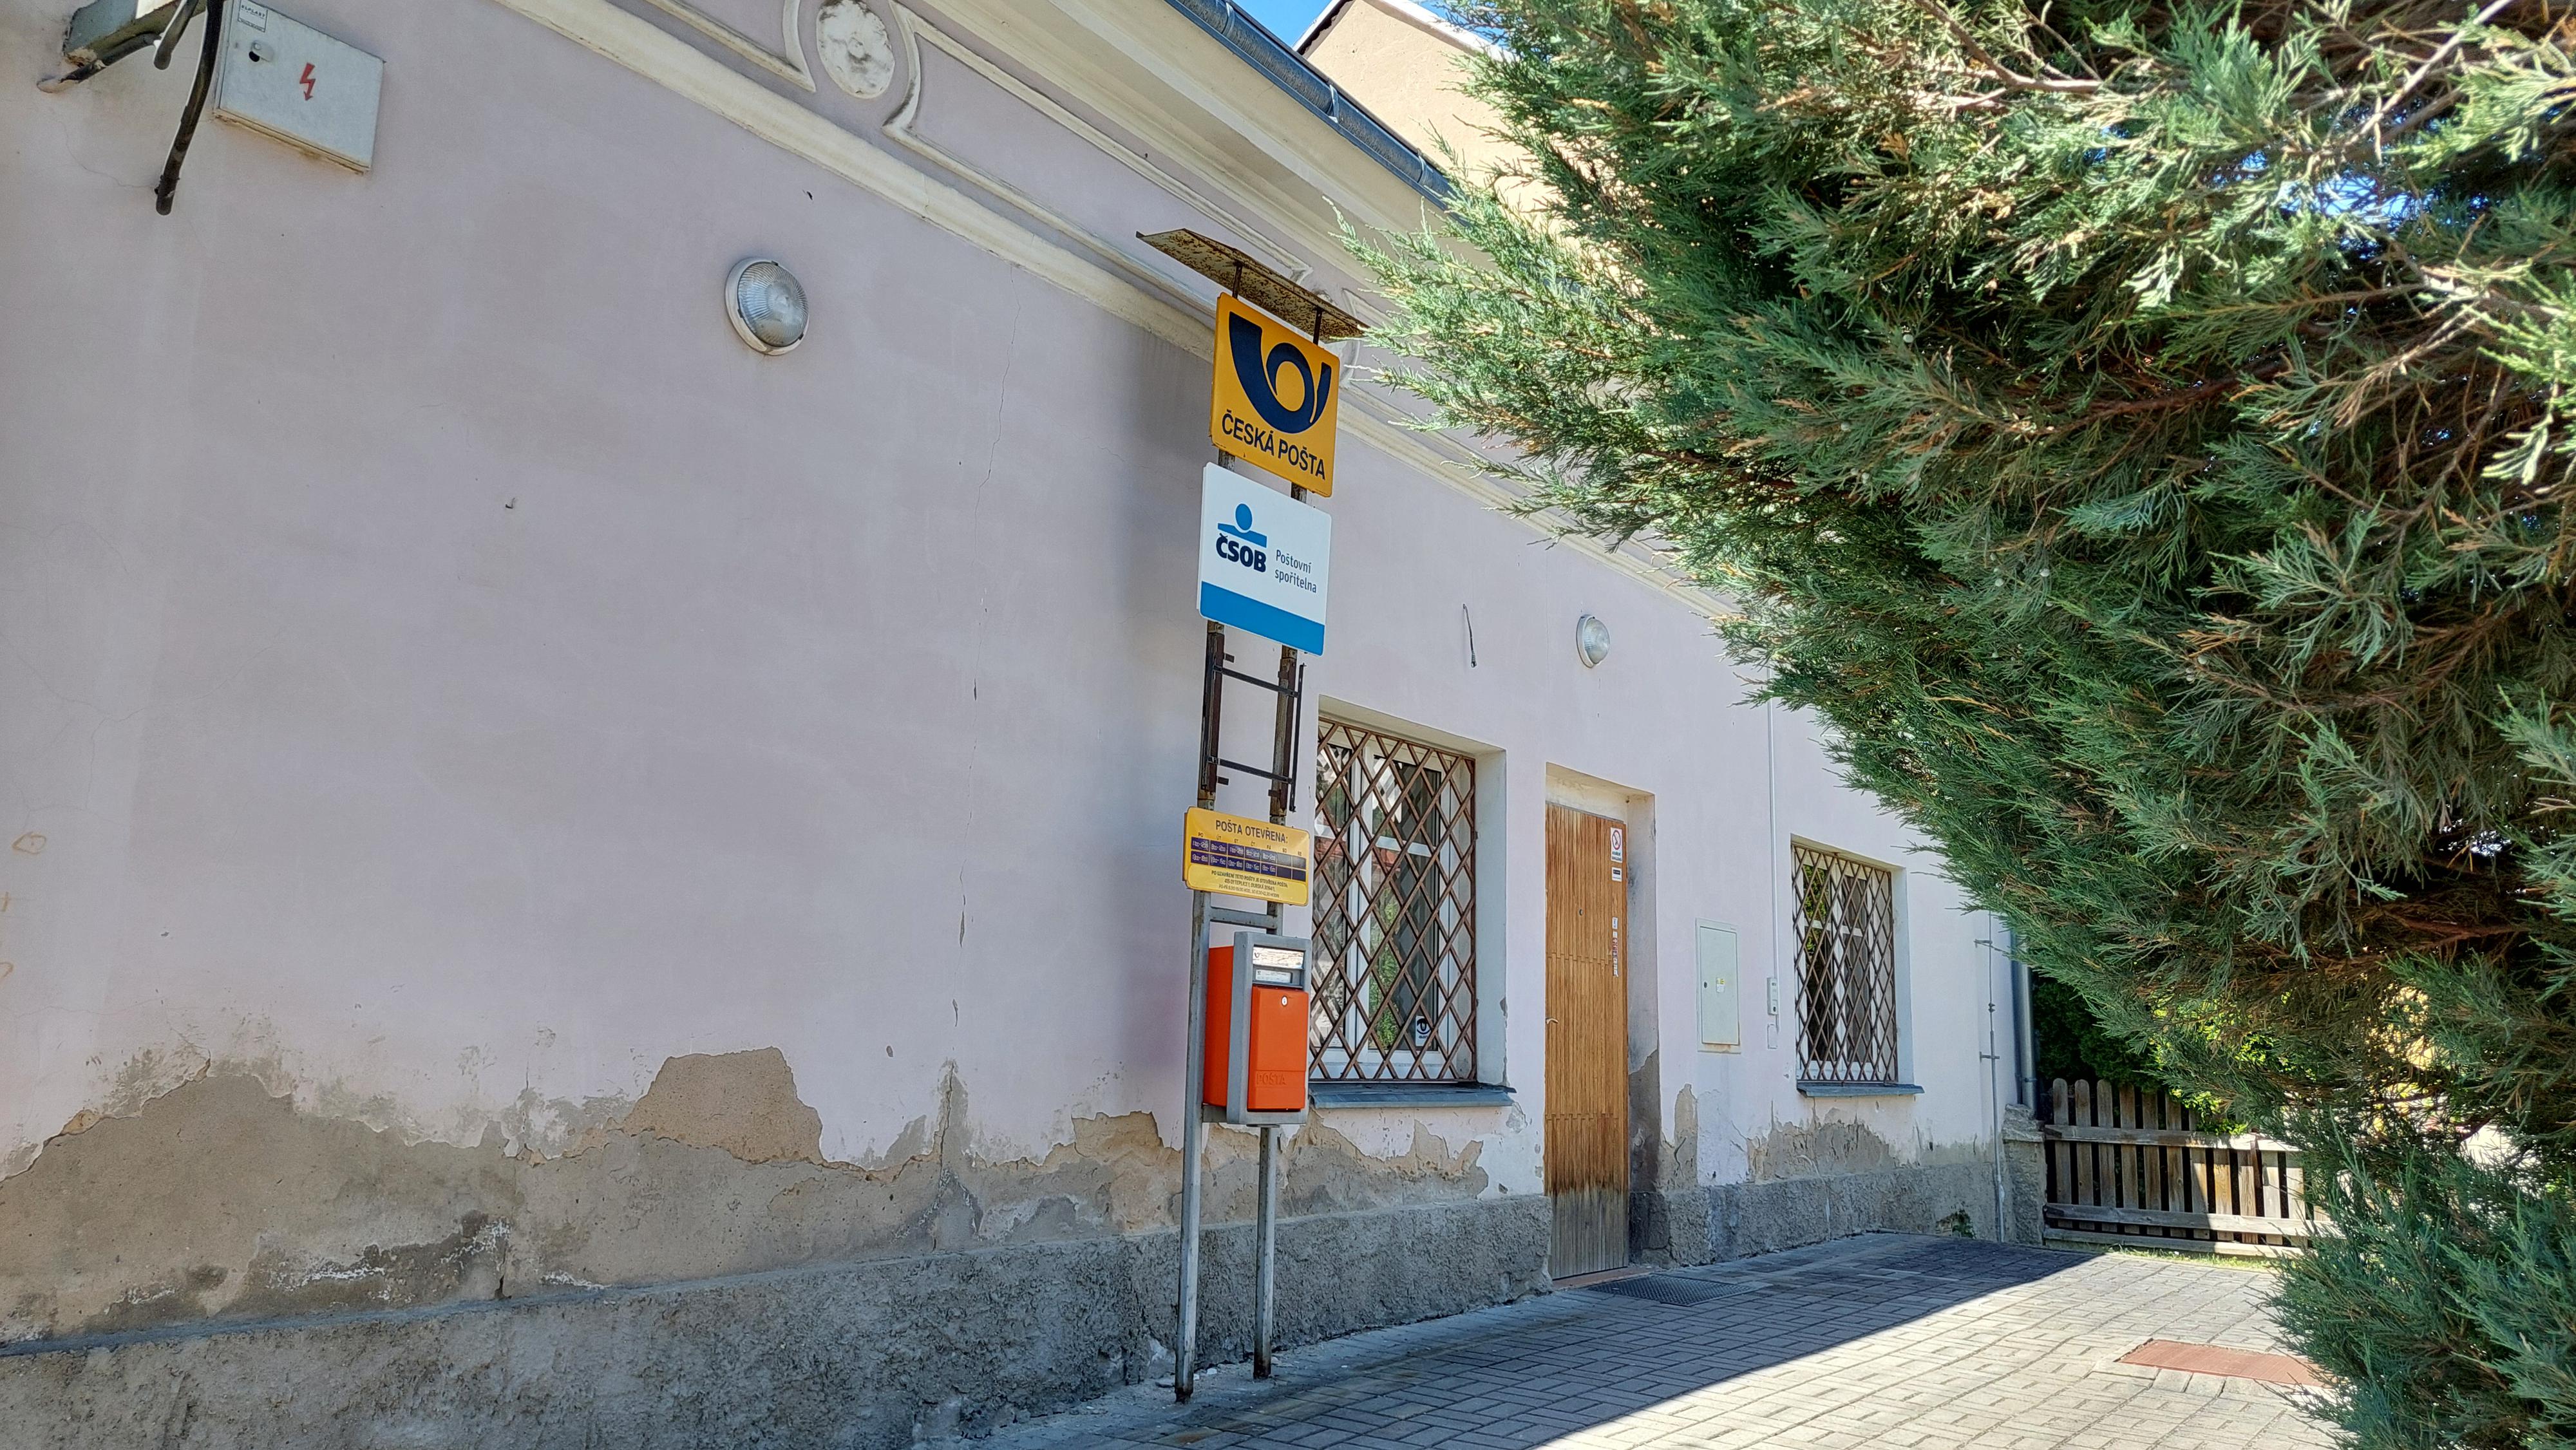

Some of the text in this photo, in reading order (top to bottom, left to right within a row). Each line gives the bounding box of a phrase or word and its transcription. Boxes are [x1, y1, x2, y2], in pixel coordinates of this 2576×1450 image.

[1222, 409, 1325, 480] ČESKÁ POŠTA
[1216, 532, 1266, 572] ČSOB
[1276, 549, 1311, 574] Poštovní
[1274, 569, 1317, 593] spořitelna
[1216, 819, 1288, 843] POŠTA OTEVŘENA:
